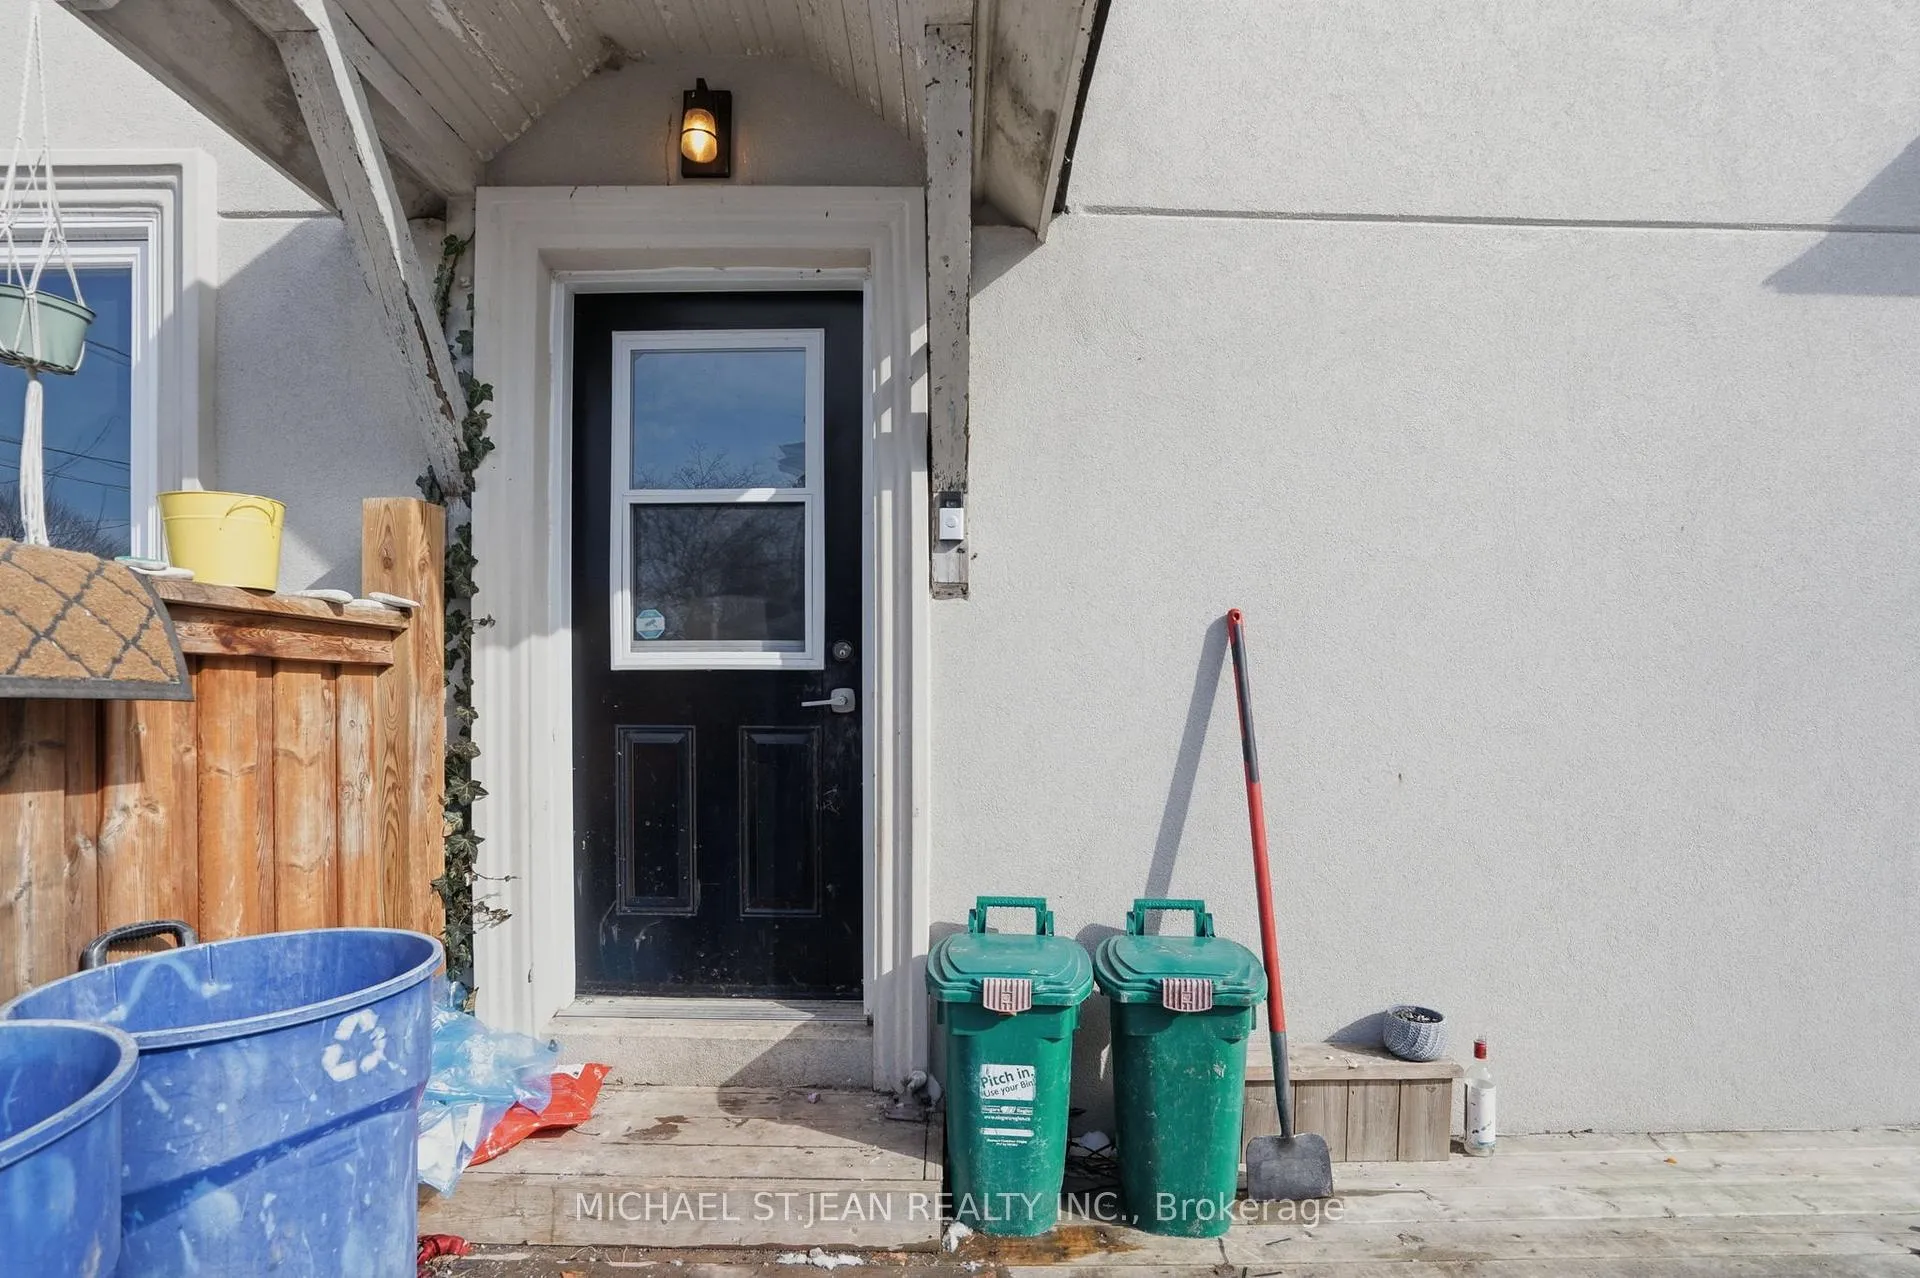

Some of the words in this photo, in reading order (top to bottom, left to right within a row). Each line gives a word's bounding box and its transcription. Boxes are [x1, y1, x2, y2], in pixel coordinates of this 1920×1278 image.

[980, 1071, 1014, 1088] Pitch
[1016, 1068, 1034, 1080] in.
[983, 1089, 999, 1097] Use
[1000, 1084, 1018, 1095] your
